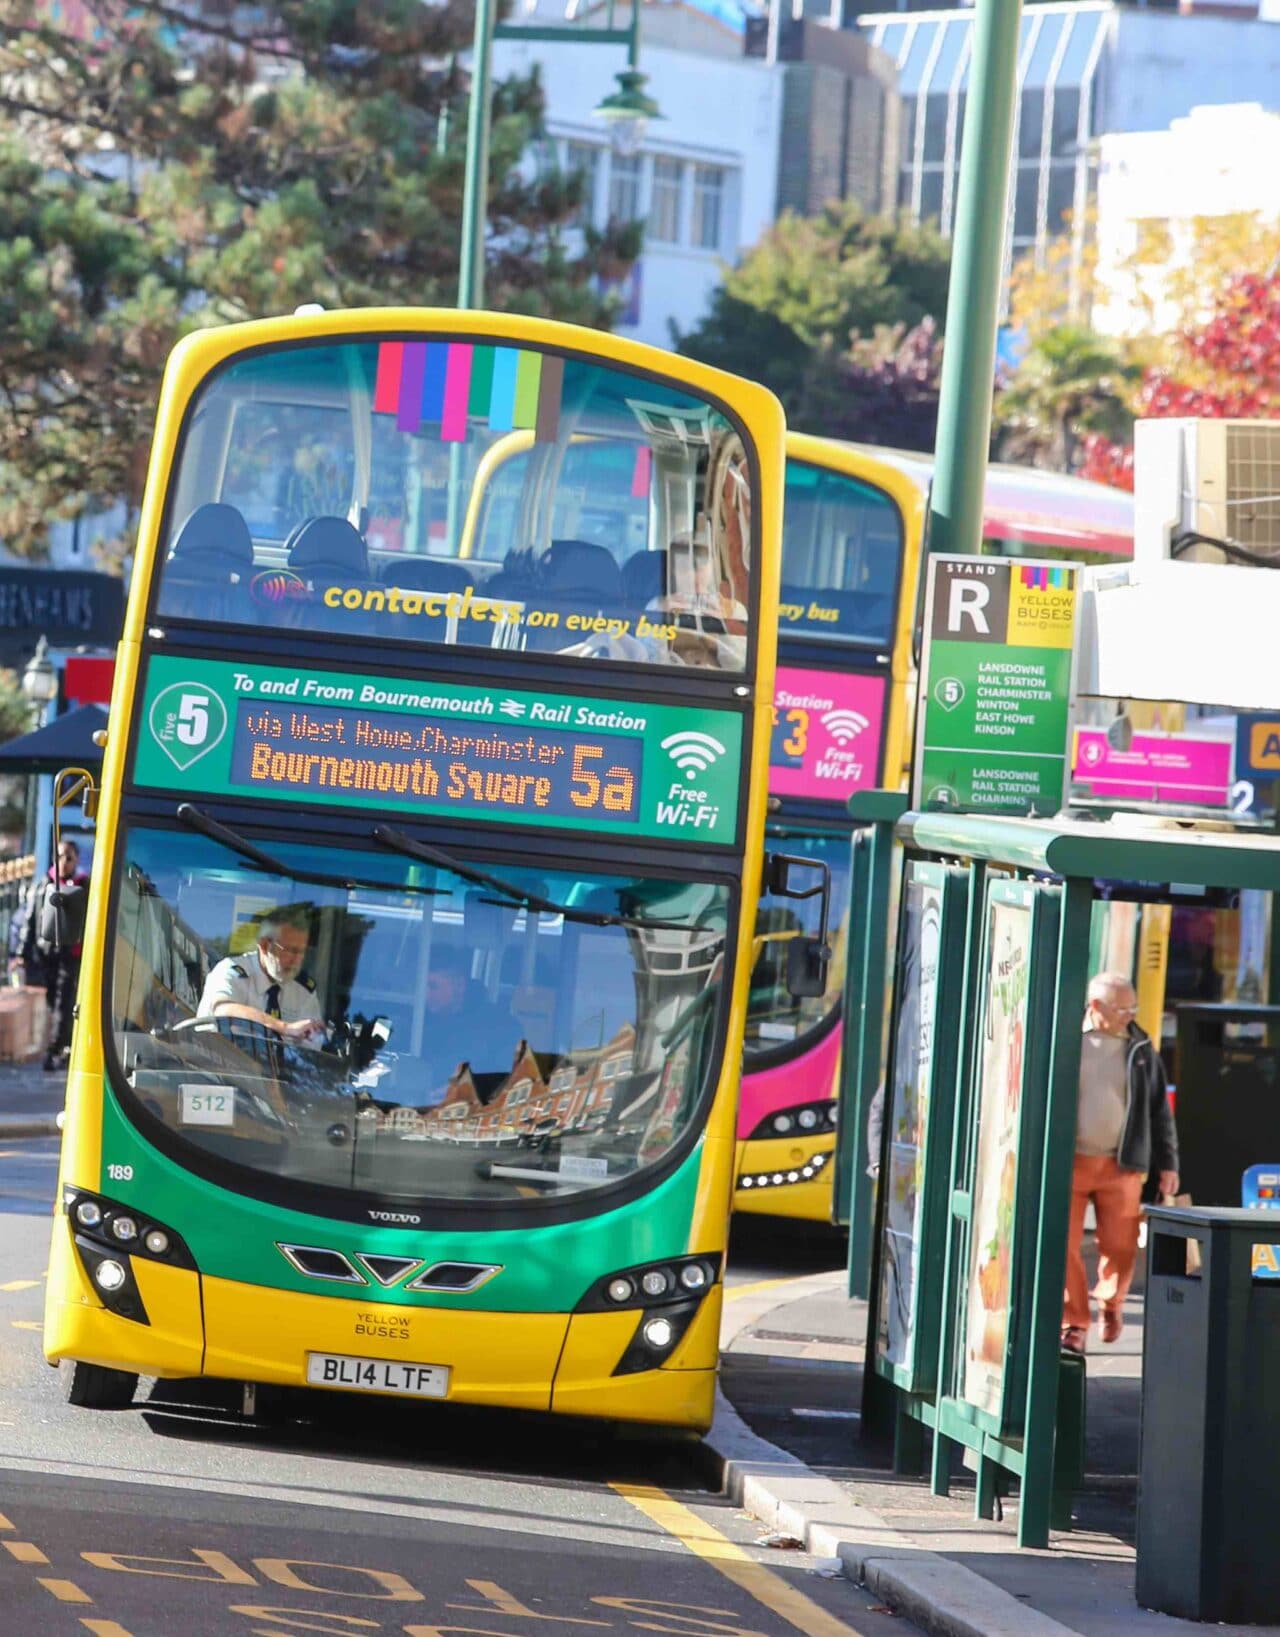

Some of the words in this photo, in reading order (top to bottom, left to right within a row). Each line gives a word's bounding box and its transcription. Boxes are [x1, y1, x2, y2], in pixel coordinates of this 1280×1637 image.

[946, 563, 997, 575] STAND
[947, 578, 991, 634] R
[1019, 595, 1073, 606] YELLOW
[323, 586, 523, 624] contactless
[528, 608, 560, 628] on
[566, 612, 630, 640] every
[636, 614, 678, 640] bus
[777, 603, 804, 621] ery
[807, 602, 840, 622] bus
[1017, 607, 1073, 621] BUSES
[978, 662, 1046, 675] LANSDOWNE
[977, 675, 1002, 686] RAIL
[1003, 676, 1047, 688] STATION
[943, 681, 958, 703] 5
[976, 687, 1052, 701] CHARMINSTER
[233, 673, 255, 691] To
[260, 678, 298, 696] and
[303, 680, 355, 701] From
[359, 684, 494, 715] Bournemouth
[529, 703, 572, 724] Rail
[575, 706, 647, 731] Station
[775, 691, 833, 711] Station
[976, 700, 1019, 711] WINTON
[177, 694, 209, 746] 5
[975, 711, 1001, 723] EAST
[1003, 713, 1036, 725] HOWE
[160, 712, 177, 742] five
[247, 710, 282, 738] via
[289, 711, 347, 744] West
[783, 708, 810, 757] 3
[974, 724, 1016, 736] KINSON
[824, 747, 855, 762] Free
[250, 742, 440, 796] Bournemouth
[446, 761, 552, 808] Square
[570, 743, 634, 812] 5a
[814, 760, 864, 781] Wi-Fi
[972, 768, 1040, 782] LANSDOWNE
[668, 783, 708, 803] Free
[971, 780, 996, 792] RAIL
[997, 782, 1040, 793] STATION
[971, 793, 1028, 806] CHARMINS
[655, 802, 720, 829] Wi-Fi
[191, 1095, 225, 1112] 512
[107, 1164, 134, 1181] 189
[368, 1210, 422, 1225] VOLVO
[357, 1313, 411, 1327] YELLOW
[355, 1324, 410, 1340] BUSES
[323, 1358, 377, 1385] BL14
[384, 1364, 433, 1390] LTF
